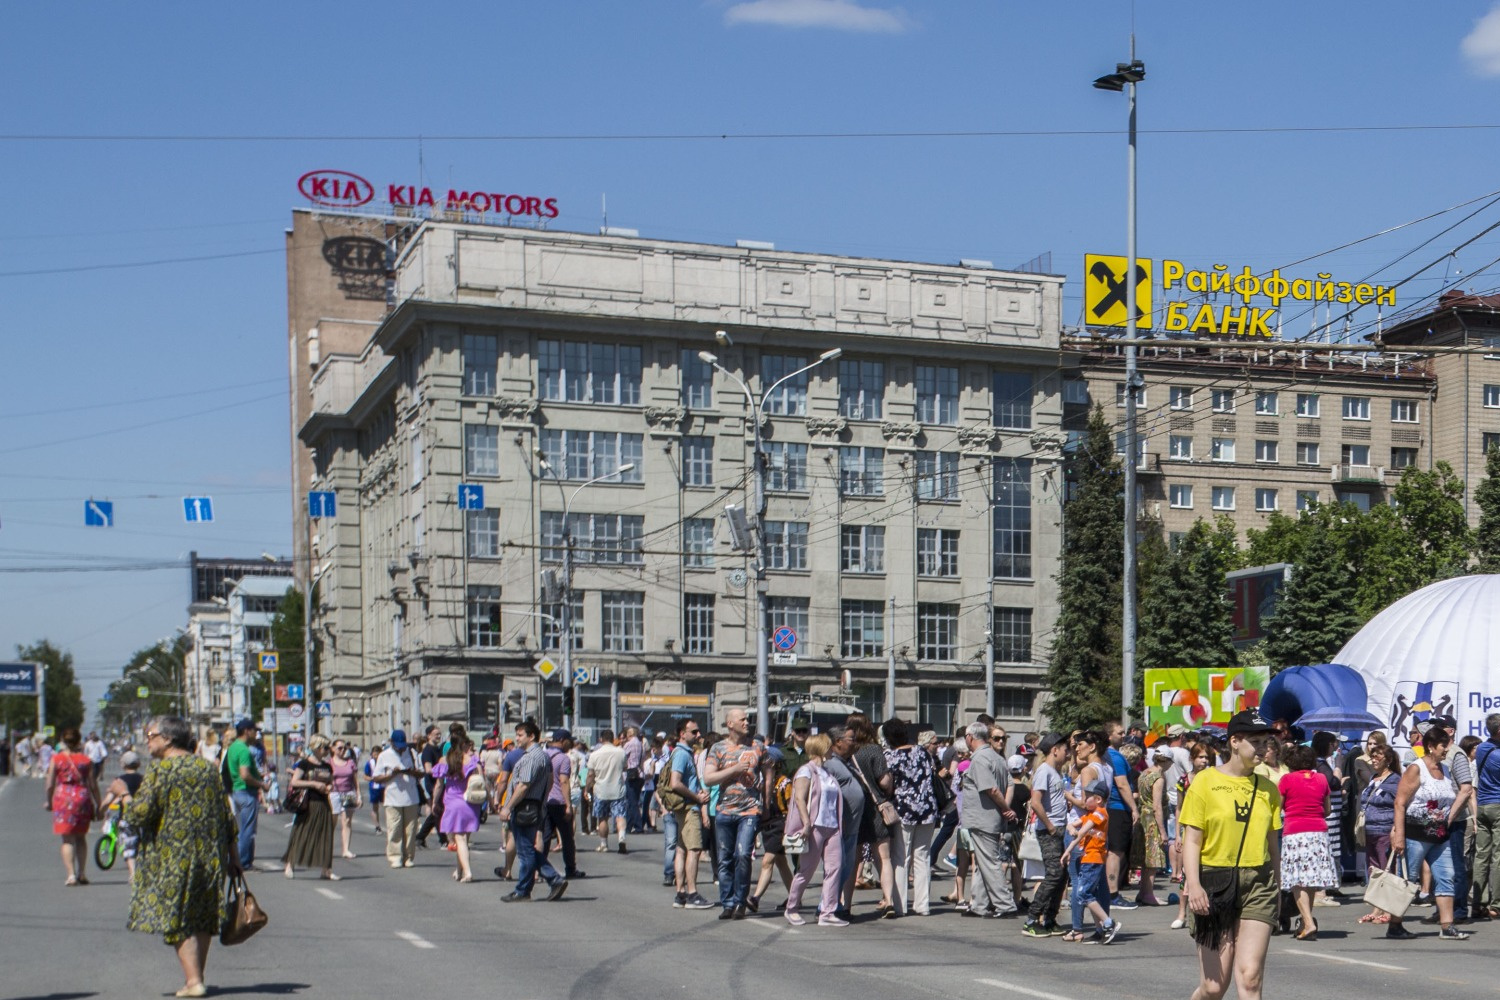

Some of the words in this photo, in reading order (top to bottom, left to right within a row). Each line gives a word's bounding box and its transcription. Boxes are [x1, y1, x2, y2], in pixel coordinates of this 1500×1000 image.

[311, 177, 361, 201] KIA
[388, 184, 434, 206] KIA
[446, 189, 559, 218] MOTORS
[1162, 259, 1396, 307] Райффайзен
[1165, 302, 1276, 337] БАНК
